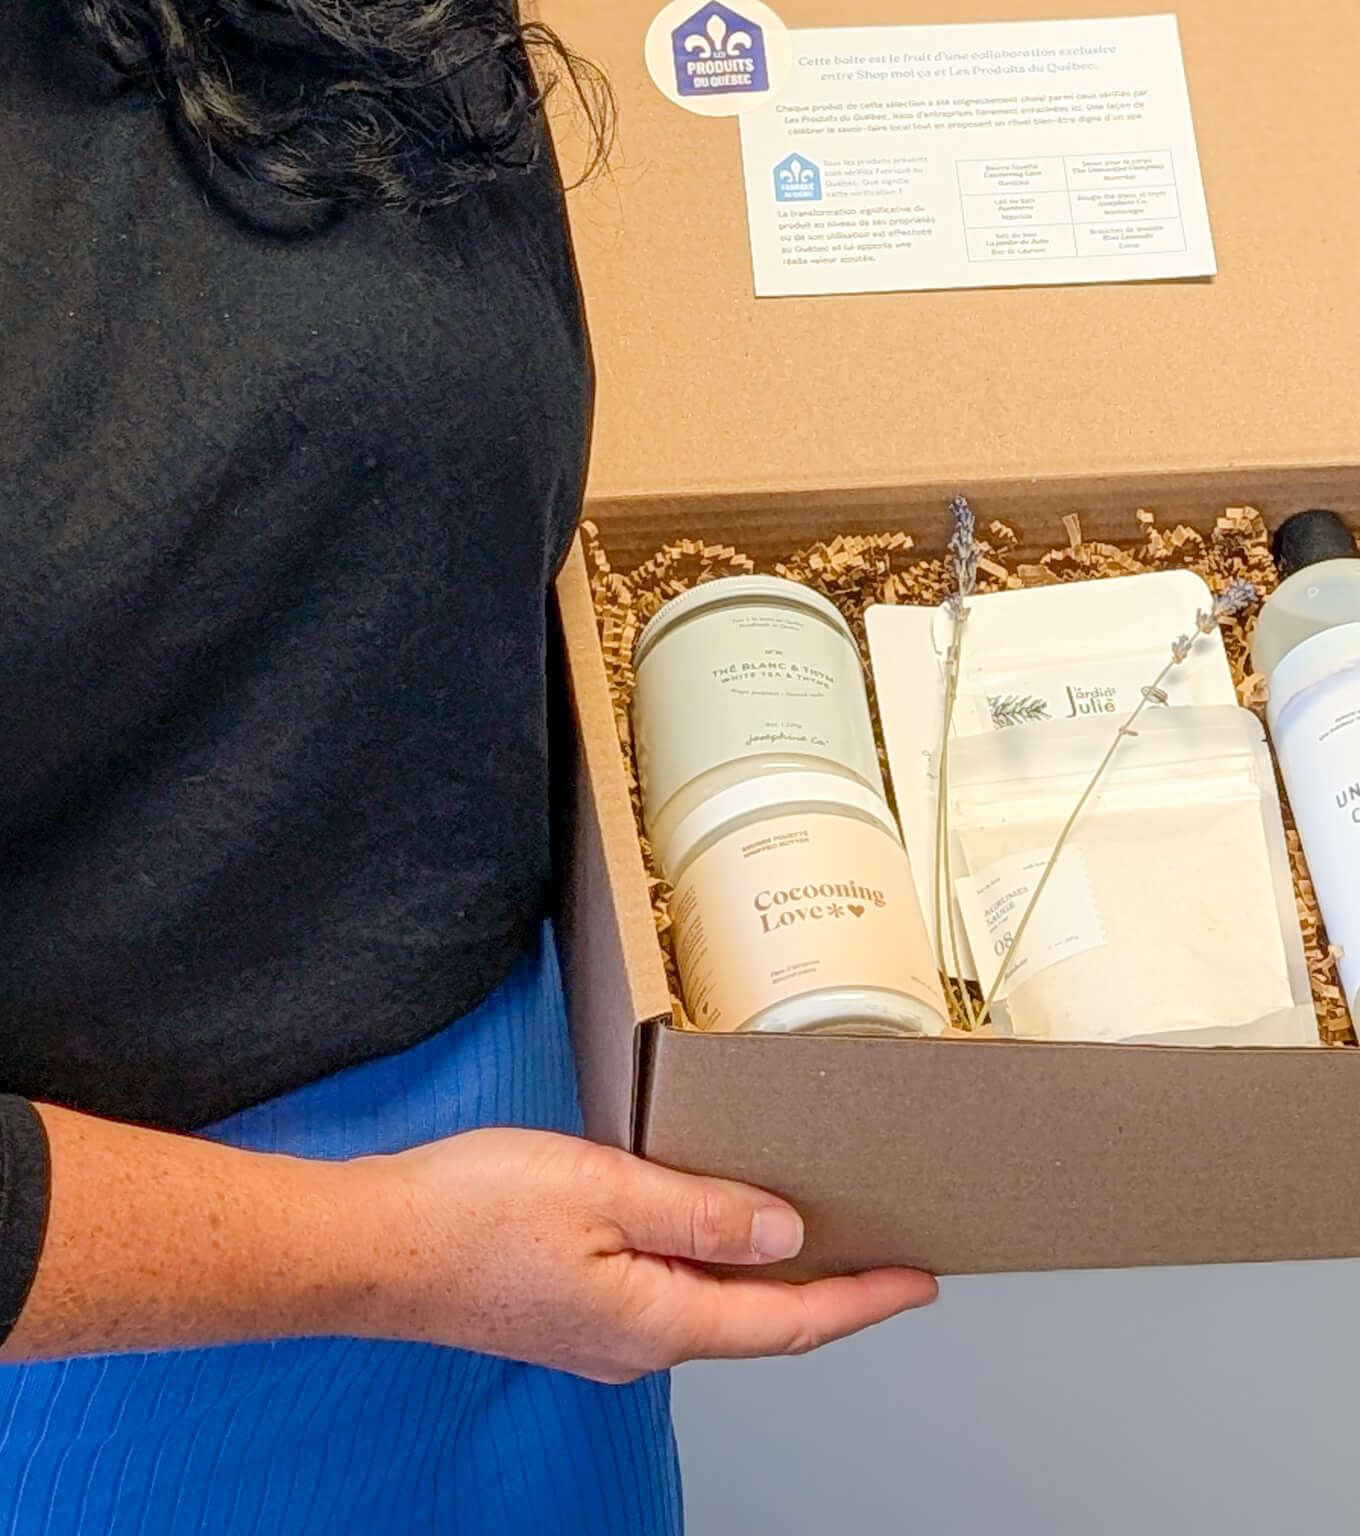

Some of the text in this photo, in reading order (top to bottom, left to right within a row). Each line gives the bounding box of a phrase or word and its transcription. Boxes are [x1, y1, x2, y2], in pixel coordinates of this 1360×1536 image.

[797, 56, 831, 66] Cette
[868, 55, 886, 64] est
[889, 53, 901, 63] le
[903, 52, 932, 63] fruit
[971, 48, 1056, 60] collaboration
[1058, 44, 1117, 56] exclusive
[686, 58, 755, 75] PRODUITS
[820, 71, 853, 80] entre
[856, 69, 889, 81] Shop
[891, 68, 915, 78] moi
[934, 68, 947, 77] et
[949, 67, 970, 76] Les
[972, 64, 1026, 75] Produits
[1028, 63, 1045, 73] du
[693, 76, 709, 88] DU
[711, 662, 835, 684] THÉ BLANC & THYM
[720, 671, 756, 684] WHITE
[753, 879, 887, 912] Cocooning
